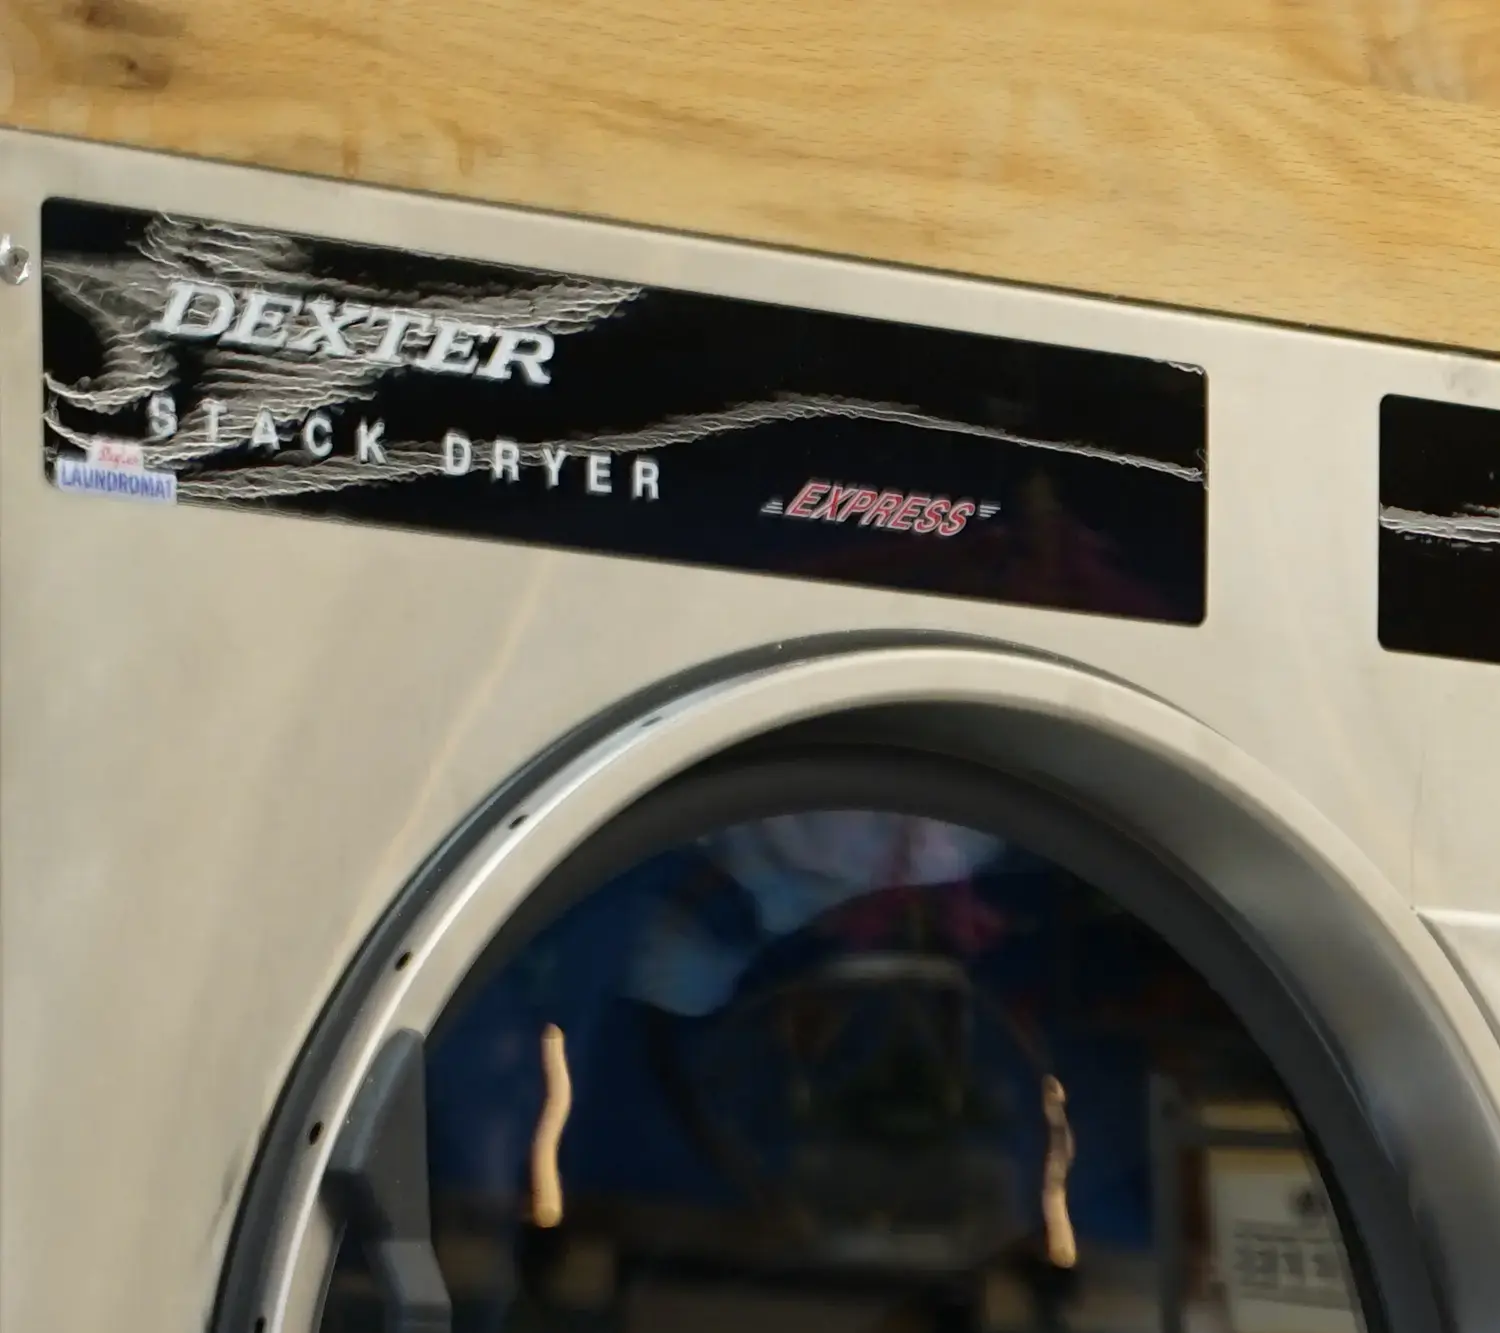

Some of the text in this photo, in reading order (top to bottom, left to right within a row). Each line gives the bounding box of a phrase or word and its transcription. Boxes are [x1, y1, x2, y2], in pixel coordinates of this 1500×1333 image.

[150, 279, 556, 385] DEXTER
[61, 464, 173, 499] LAUNDROMAT
[148, 393, 660, 500] STACK DRYER
[785, 480, 976, 536] EXPRESS
